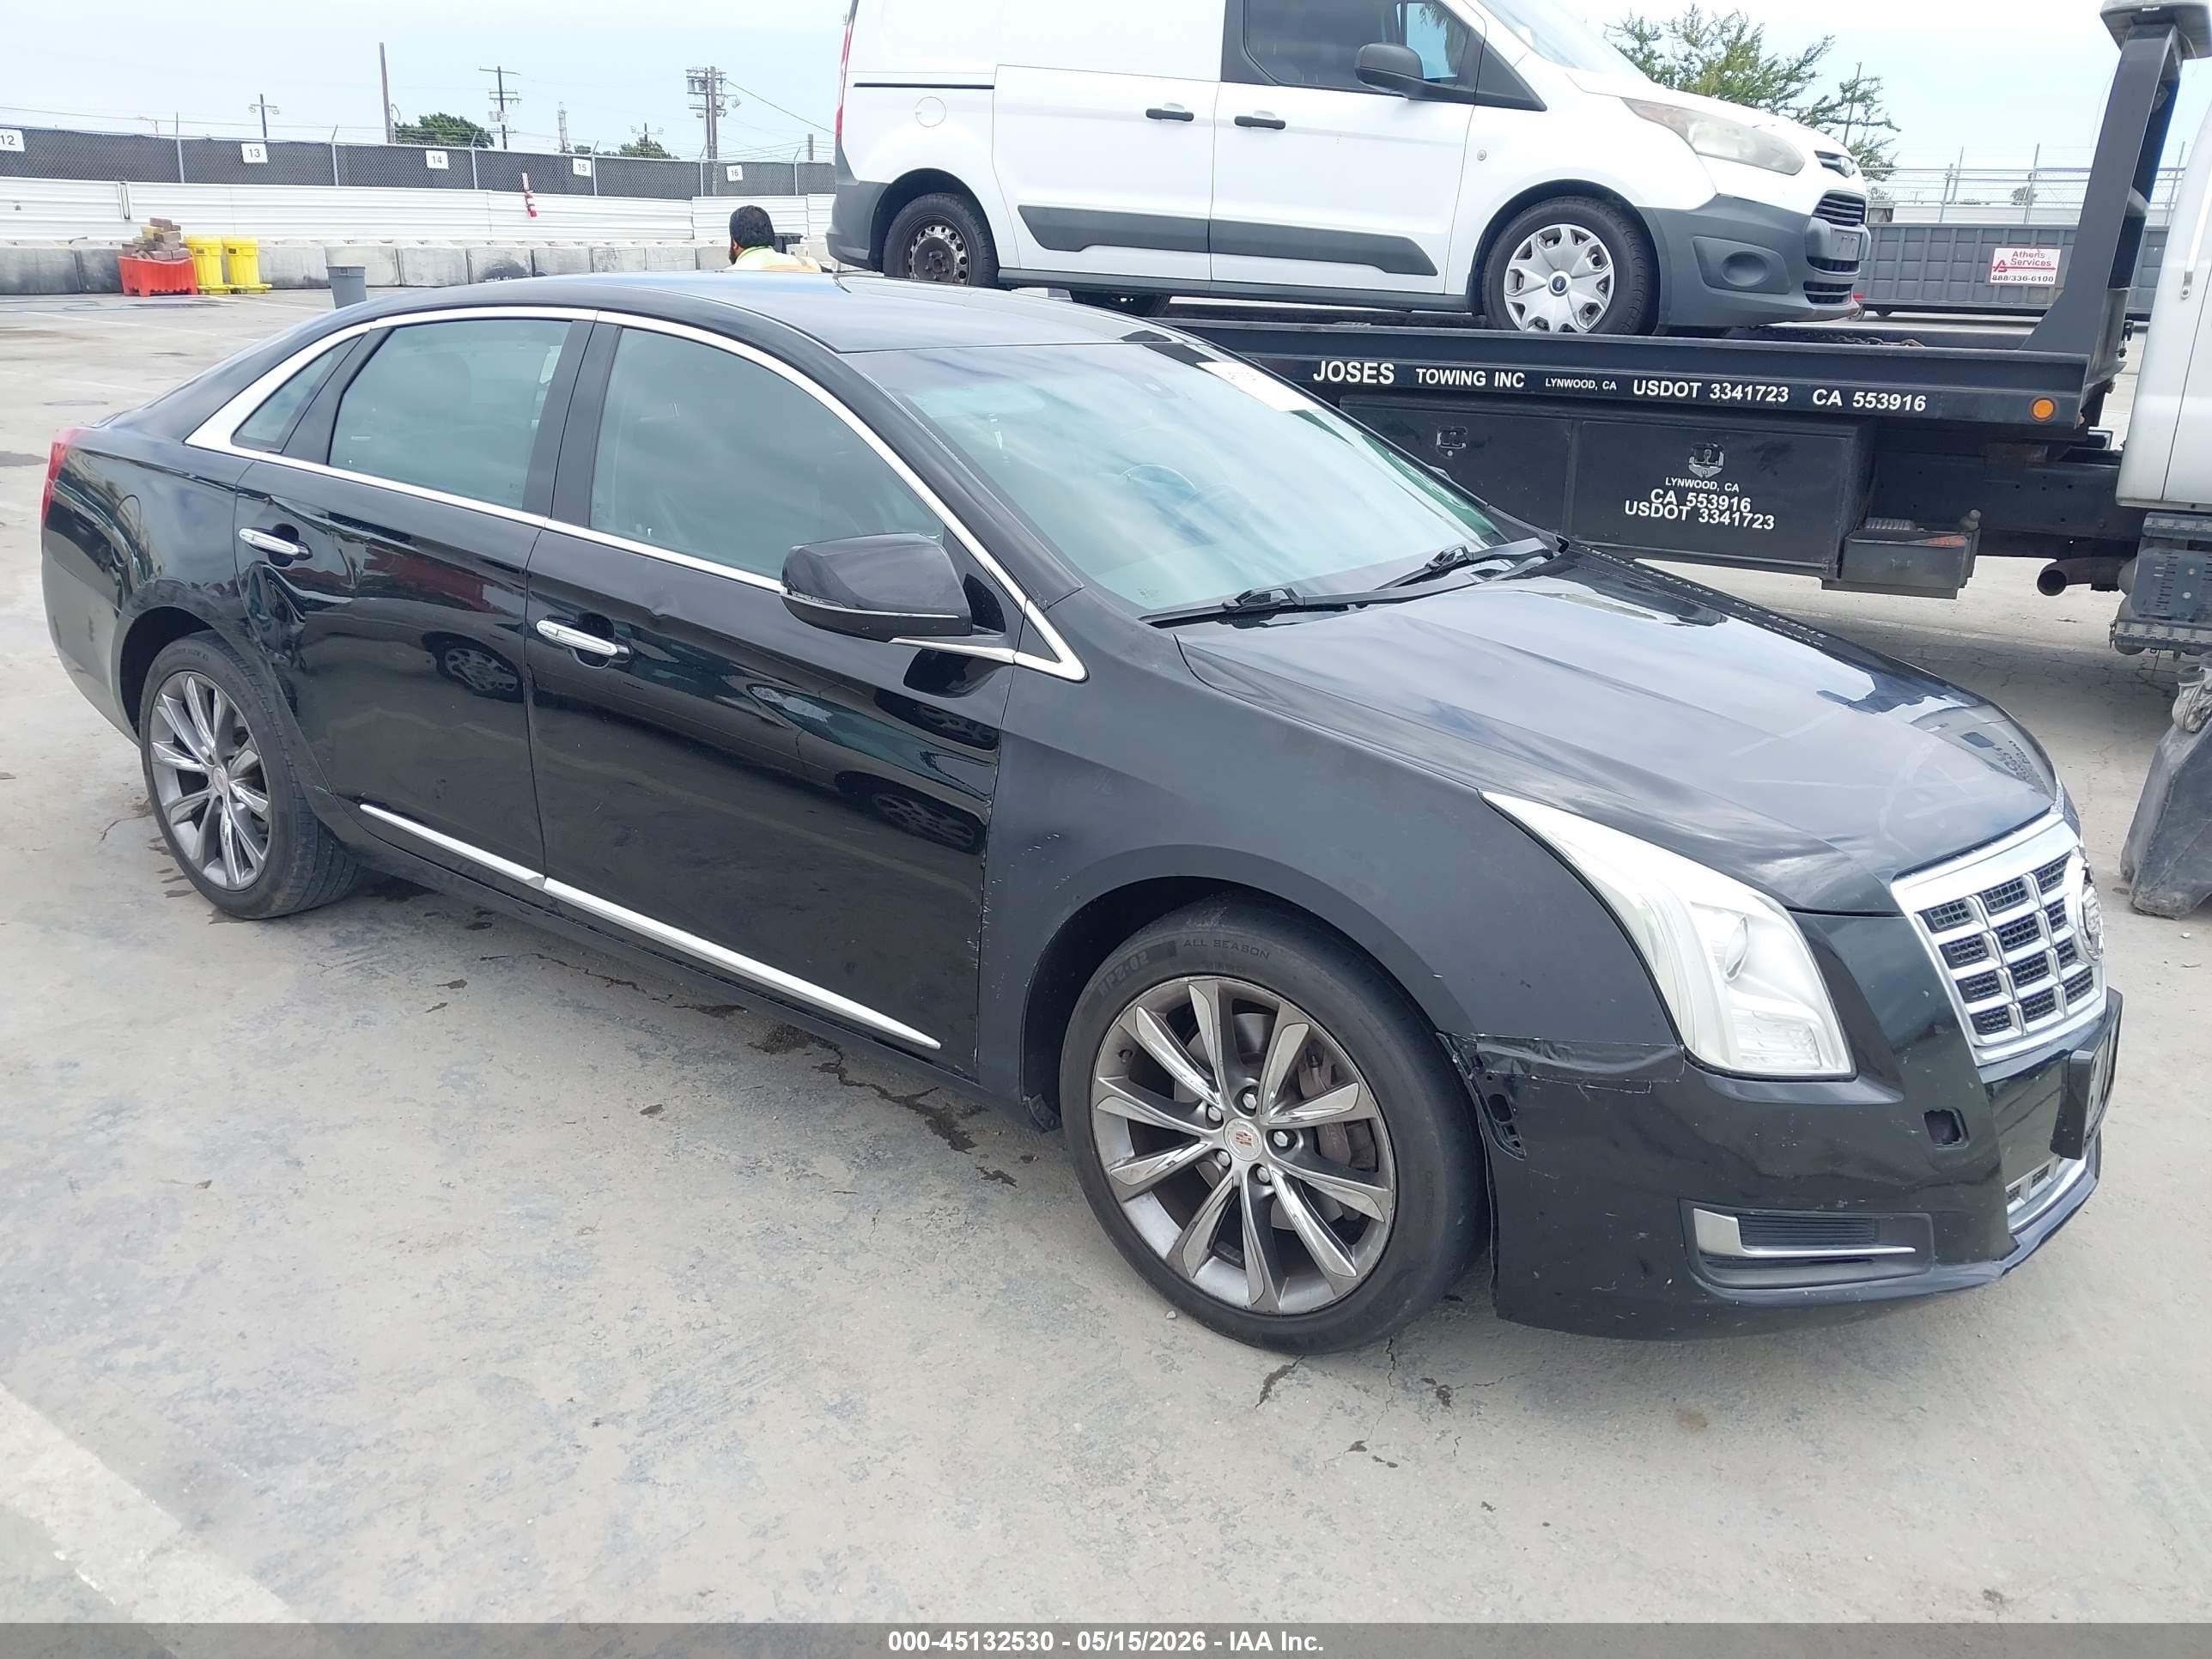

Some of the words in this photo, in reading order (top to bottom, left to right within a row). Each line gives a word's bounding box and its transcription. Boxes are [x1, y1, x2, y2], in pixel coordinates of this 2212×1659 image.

[0, 134, 15, 145] 12
[249, 148, 261, 159] 13
[431, 155, 442, 165] 14
[578, 163, 587, 173] 15
[2010, 258, 2051, 267] Services
[1313, 359, 1395, 385] JOSES
[1415, 368, 1486, 387] TOWING
[1494, 370, 1527, 389] INC
[1545, 378, 1598, 392] LYNWOOD,
[1602, 380, 1618, 391] CA
[1633, 380, 1702, 399] USDOT
[1709, 382, 1790, 404] 3341723
[1812, 388, 1844, 407] CA
[1852, 390, 1926, 412] 553916
[1665, 477, 1720, 492] LYNWOOD,
[1724, 482, 1740, 493] CA
[1650, 489, 1678, 505] CA
[1685, 491, 1752, 514] 553916
[1625, 500, 1692, 521] USDOT
[1698, 507, 1775, 530] 3341723
[1183, 939, 1208, 948] ALL
[1212, 939, 1271, 960] SEASON
